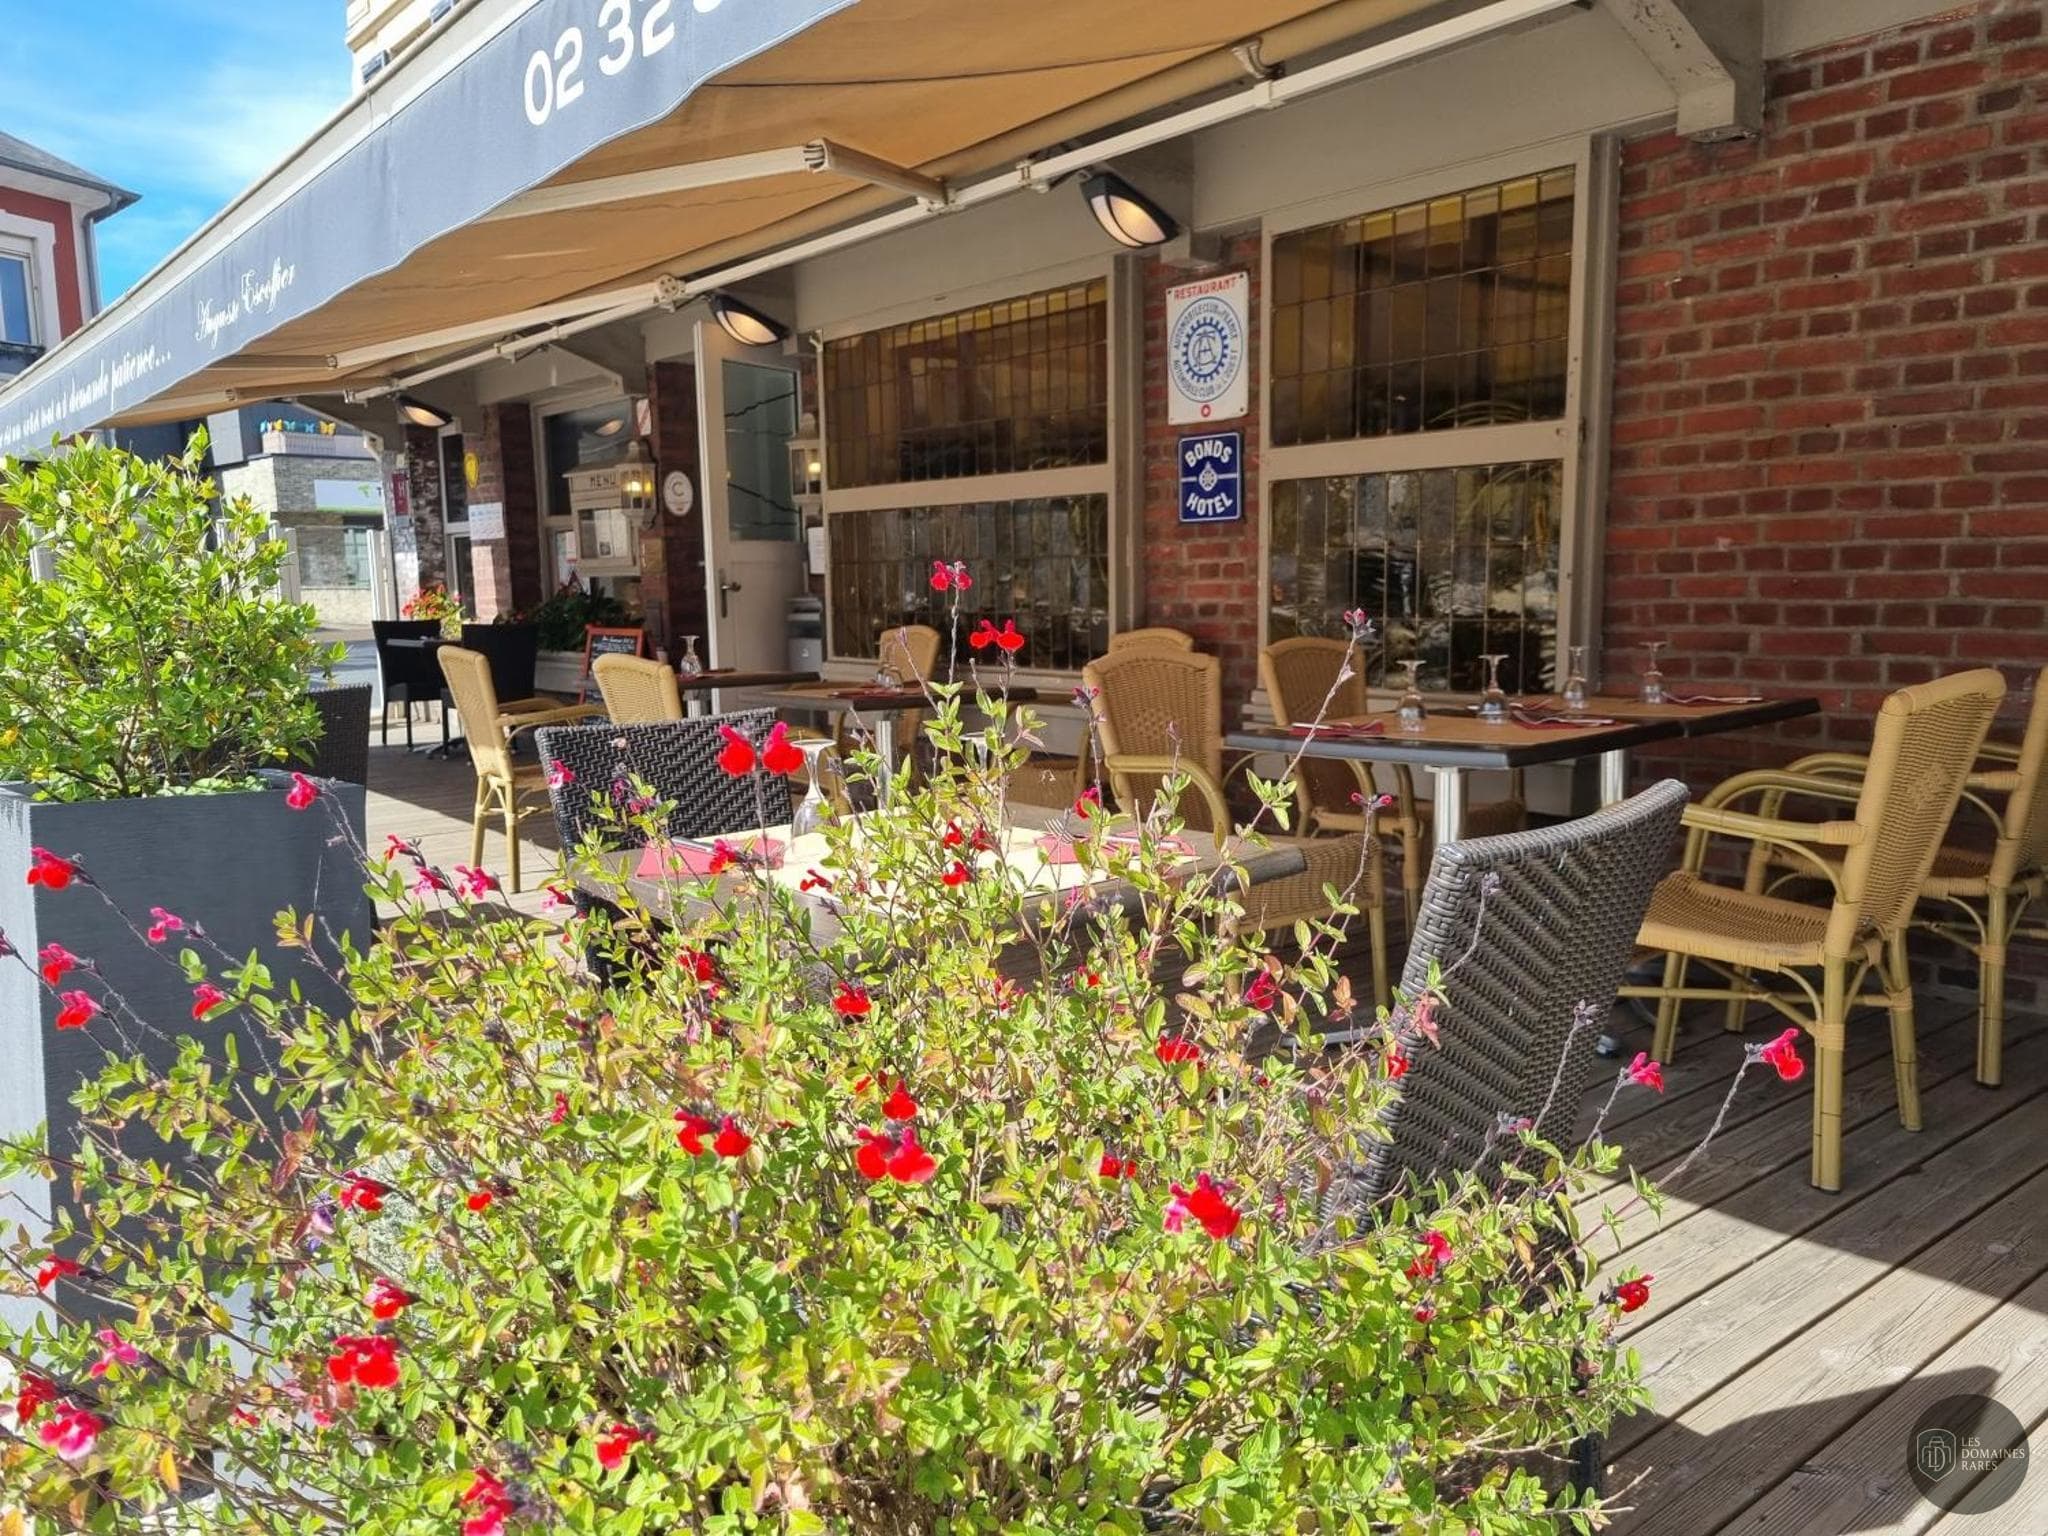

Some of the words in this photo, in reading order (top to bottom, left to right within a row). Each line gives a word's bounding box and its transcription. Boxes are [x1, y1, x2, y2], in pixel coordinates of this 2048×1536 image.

[524, 26, 585, 126] 02
[598, 0, 676, 76] 32
[241, 256, 295, 314] Escoffier
[1174, 276, 1237, 300] RESTAURANT
[1184, 440, 1232, 467] BONDS
[590, 473, 616, 488] MENU
[1186, 492, 1233, 516] HOTEL
